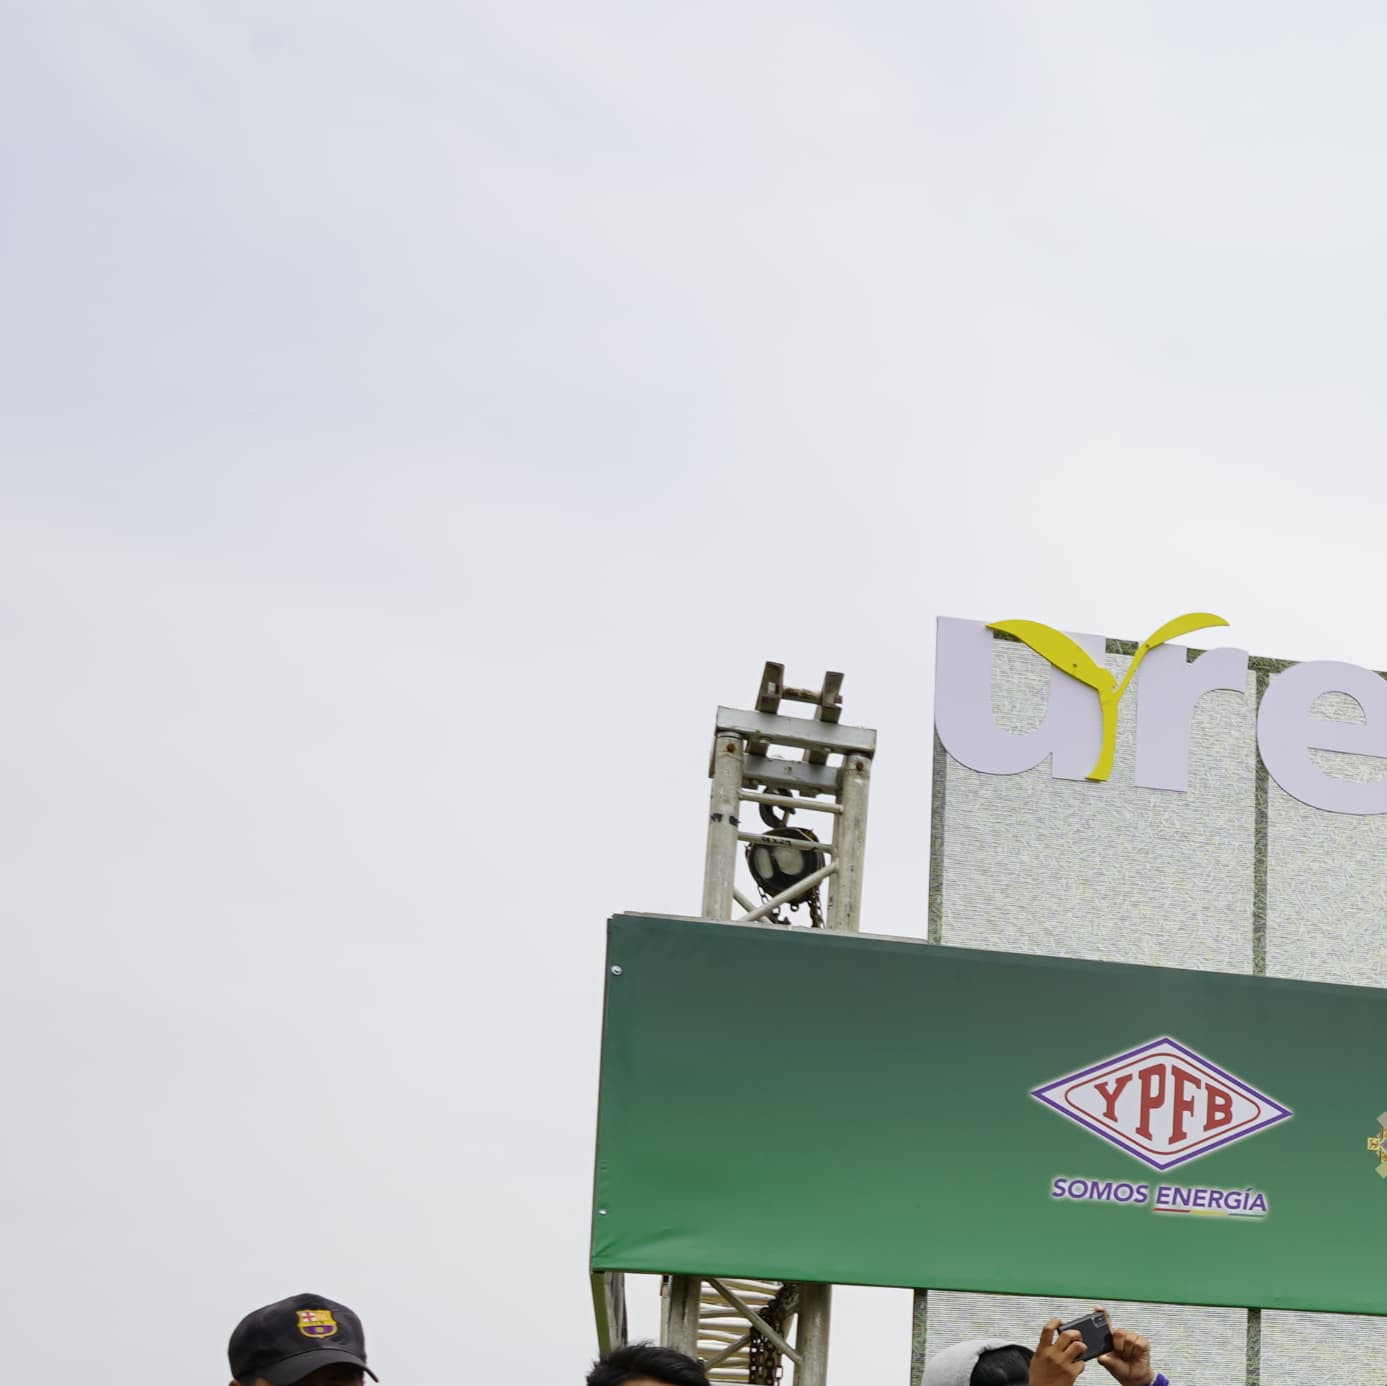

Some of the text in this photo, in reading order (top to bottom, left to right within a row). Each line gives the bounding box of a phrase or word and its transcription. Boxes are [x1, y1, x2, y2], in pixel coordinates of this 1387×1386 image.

[1094, 1063, 1233, 1145] YPFB
[1052, 1178, 1267, 1212] SOMOS ENERGÍA
